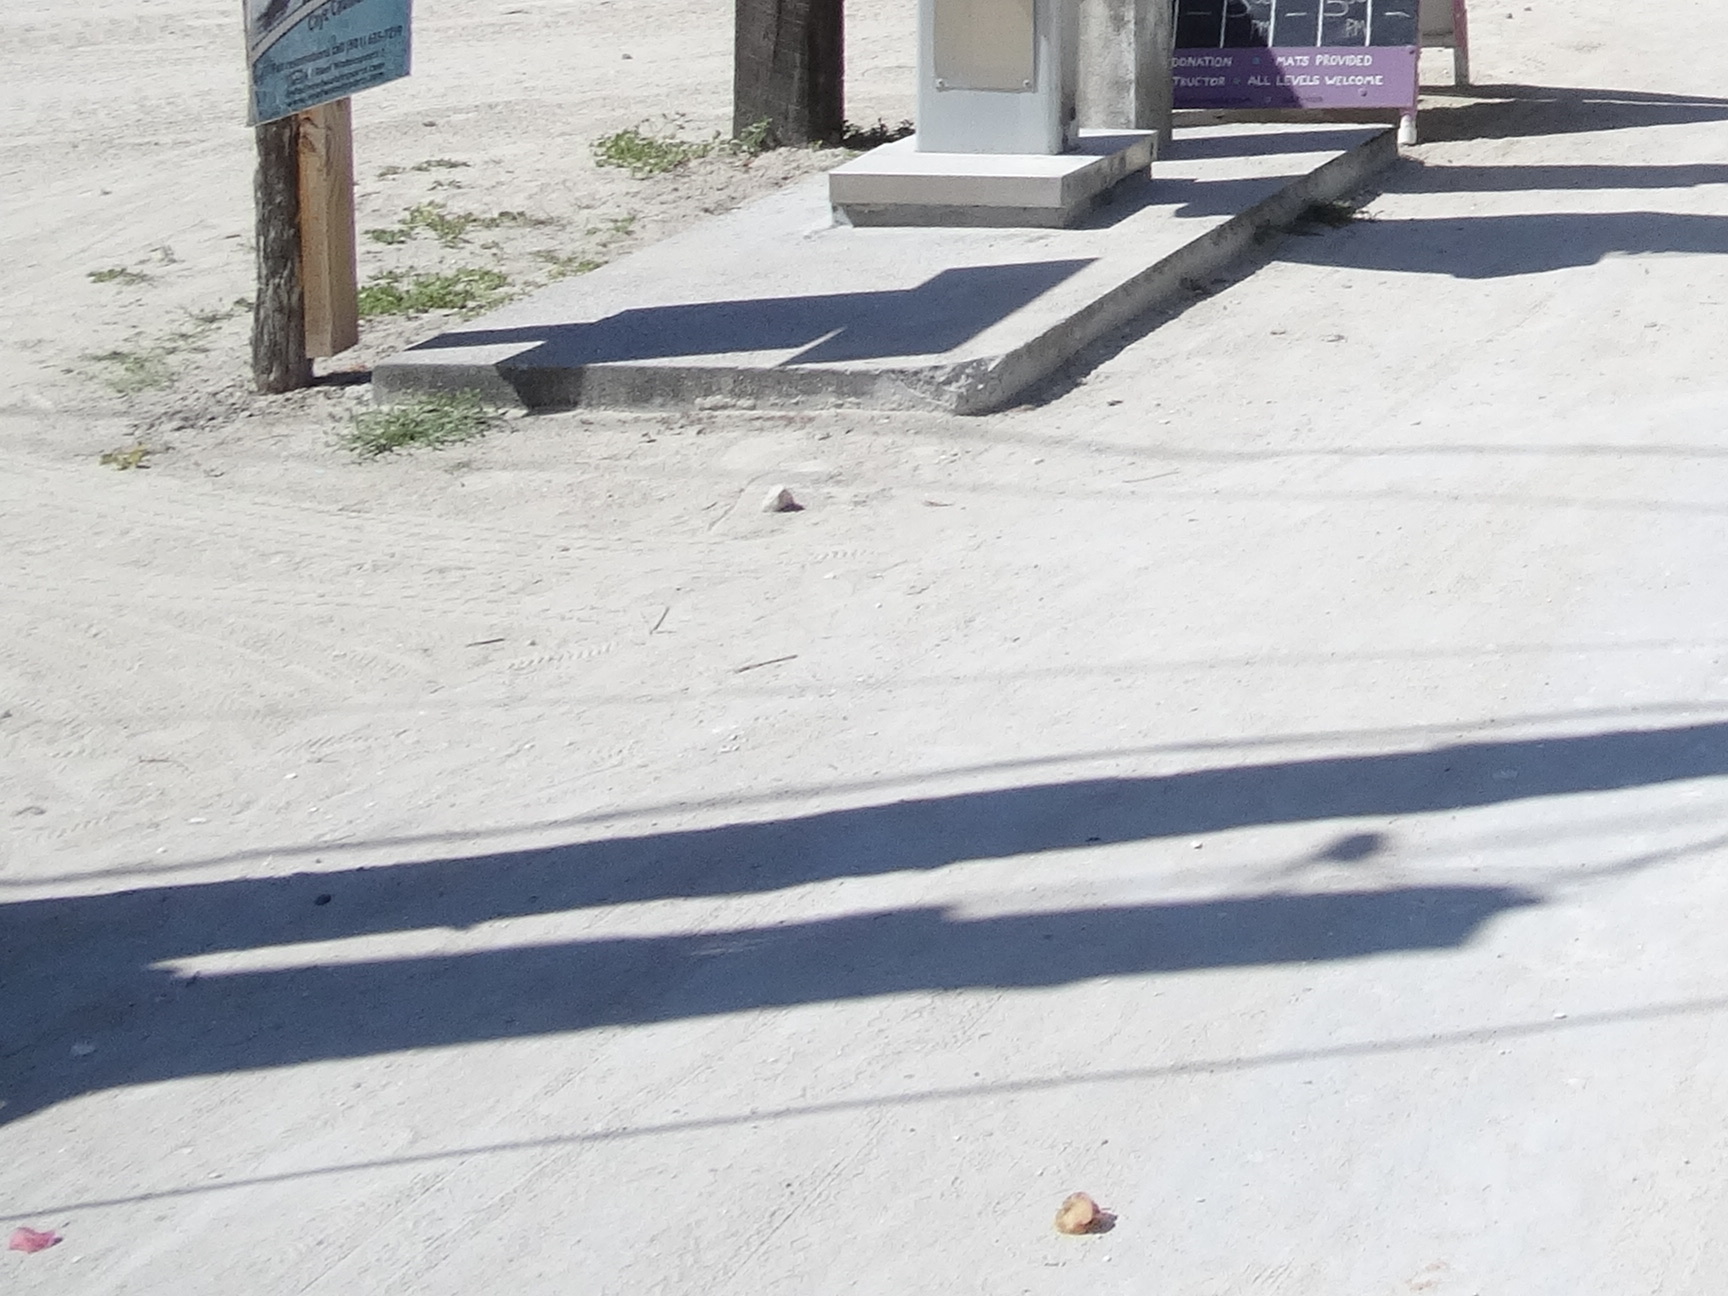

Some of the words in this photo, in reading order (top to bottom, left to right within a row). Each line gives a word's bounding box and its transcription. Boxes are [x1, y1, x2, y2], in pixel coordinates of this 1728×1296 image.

[1275, 55, 1309, 67] MATS
[1315, 54, 1372, 67] PROVIDED
[1173, 75, 1225, 86] TRUCTOR
[1247, 75, 1271, 86] ALL
[1276, 74, 1320, 86] LEVELS
[1325, 74, 1384, 86] WELCOME
